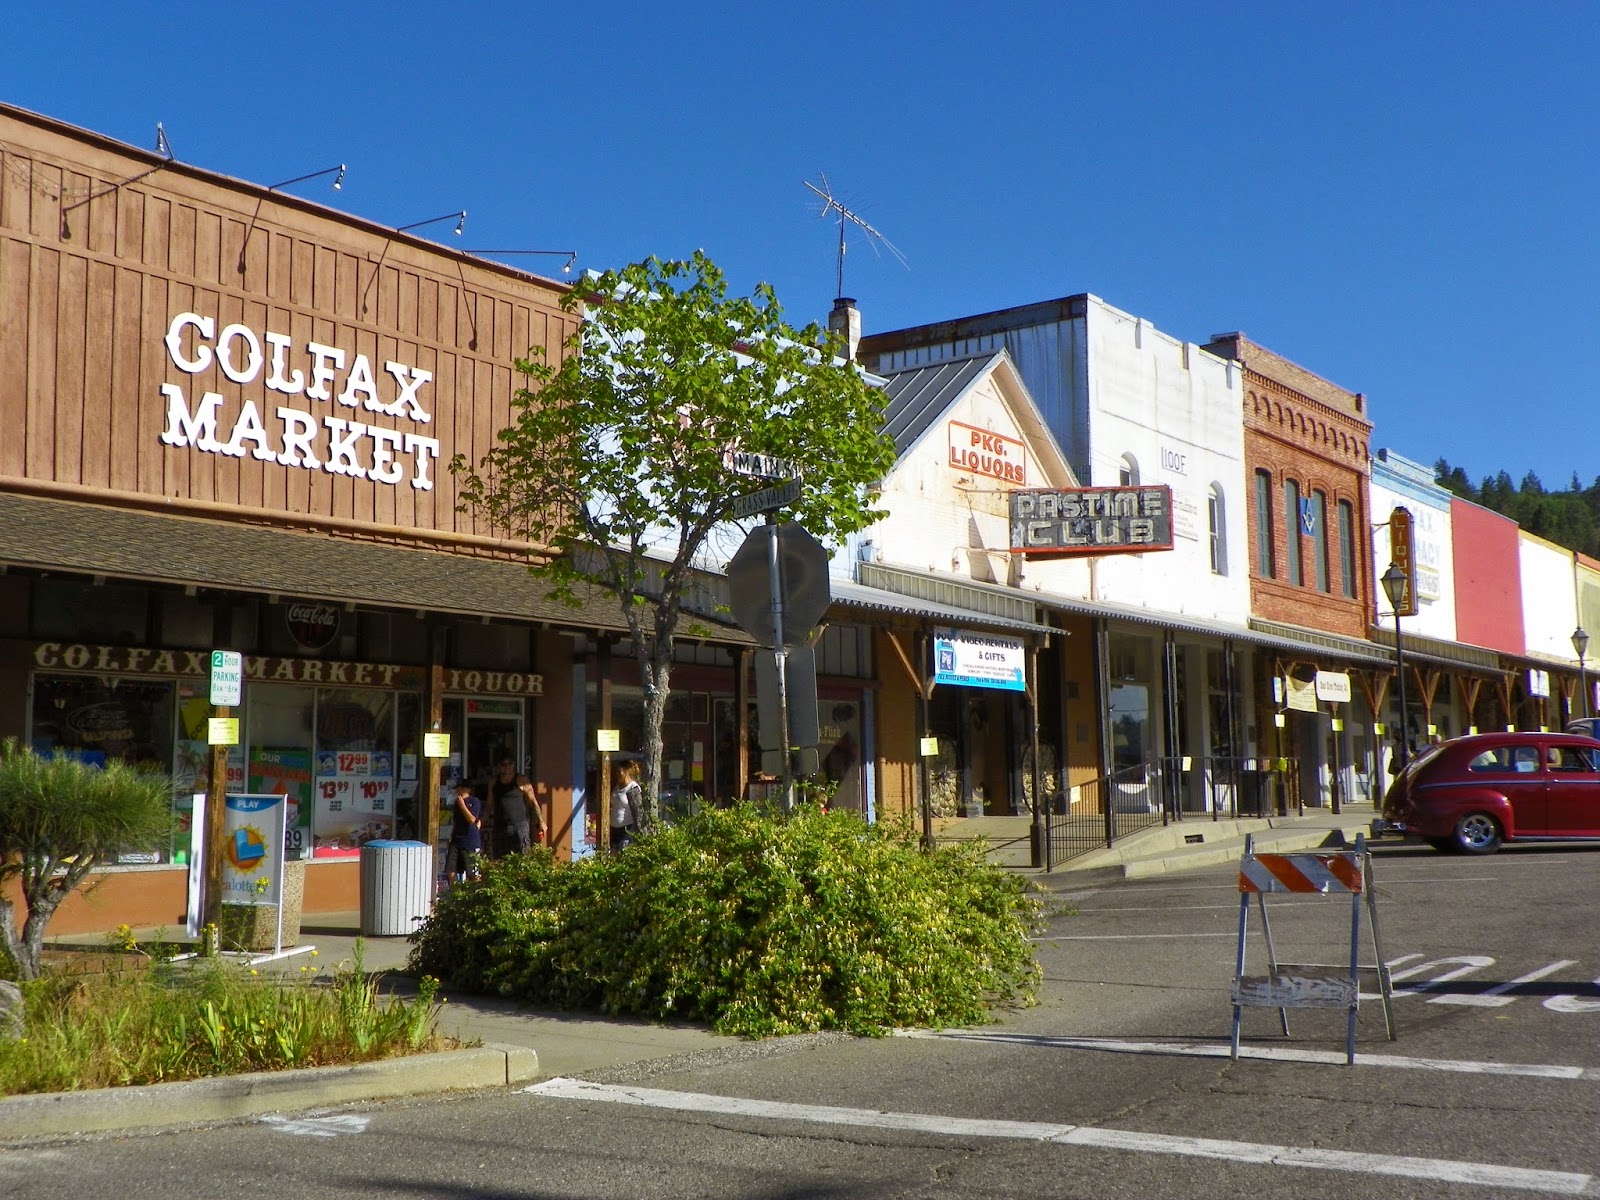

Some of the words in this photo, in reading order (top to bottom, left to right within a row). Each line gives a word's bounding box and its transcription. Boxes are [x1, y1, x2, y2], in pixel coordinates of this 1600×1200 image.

[165, 312, 433, 423] COLFAX
[160, 383, 440, 491] MARKET
[970, 430, 1008, 456] PKG.
[738, 453, 779, 476] MAIN
[951, 446, 1024, 482] LIQUORS
[1164, 449, 1187, 473] IOOF
[736, 492, 764, 516] GRASS
[1016, 490, 1162, 519] PASTIME
[1027, 517, 1155, 546] CLUB
[960, 634, 984, 647] VIDEO
[984, 638, 1019, 650] RENTALS
[35, 643, 207, 674] COLFAX
[242, 656, 401, 686] MARKET
[442, 670, 544, 694] IQUOR
[214, 653, 222, 666] 2
[224, 657, 239, 667] HOUR
[985, 652, 1006, 662] GIFTS
[213, 671, 239, 683] PARKING
[260, 752, 281, 764] OUR
[237, 799, 259, 808] PLAY
